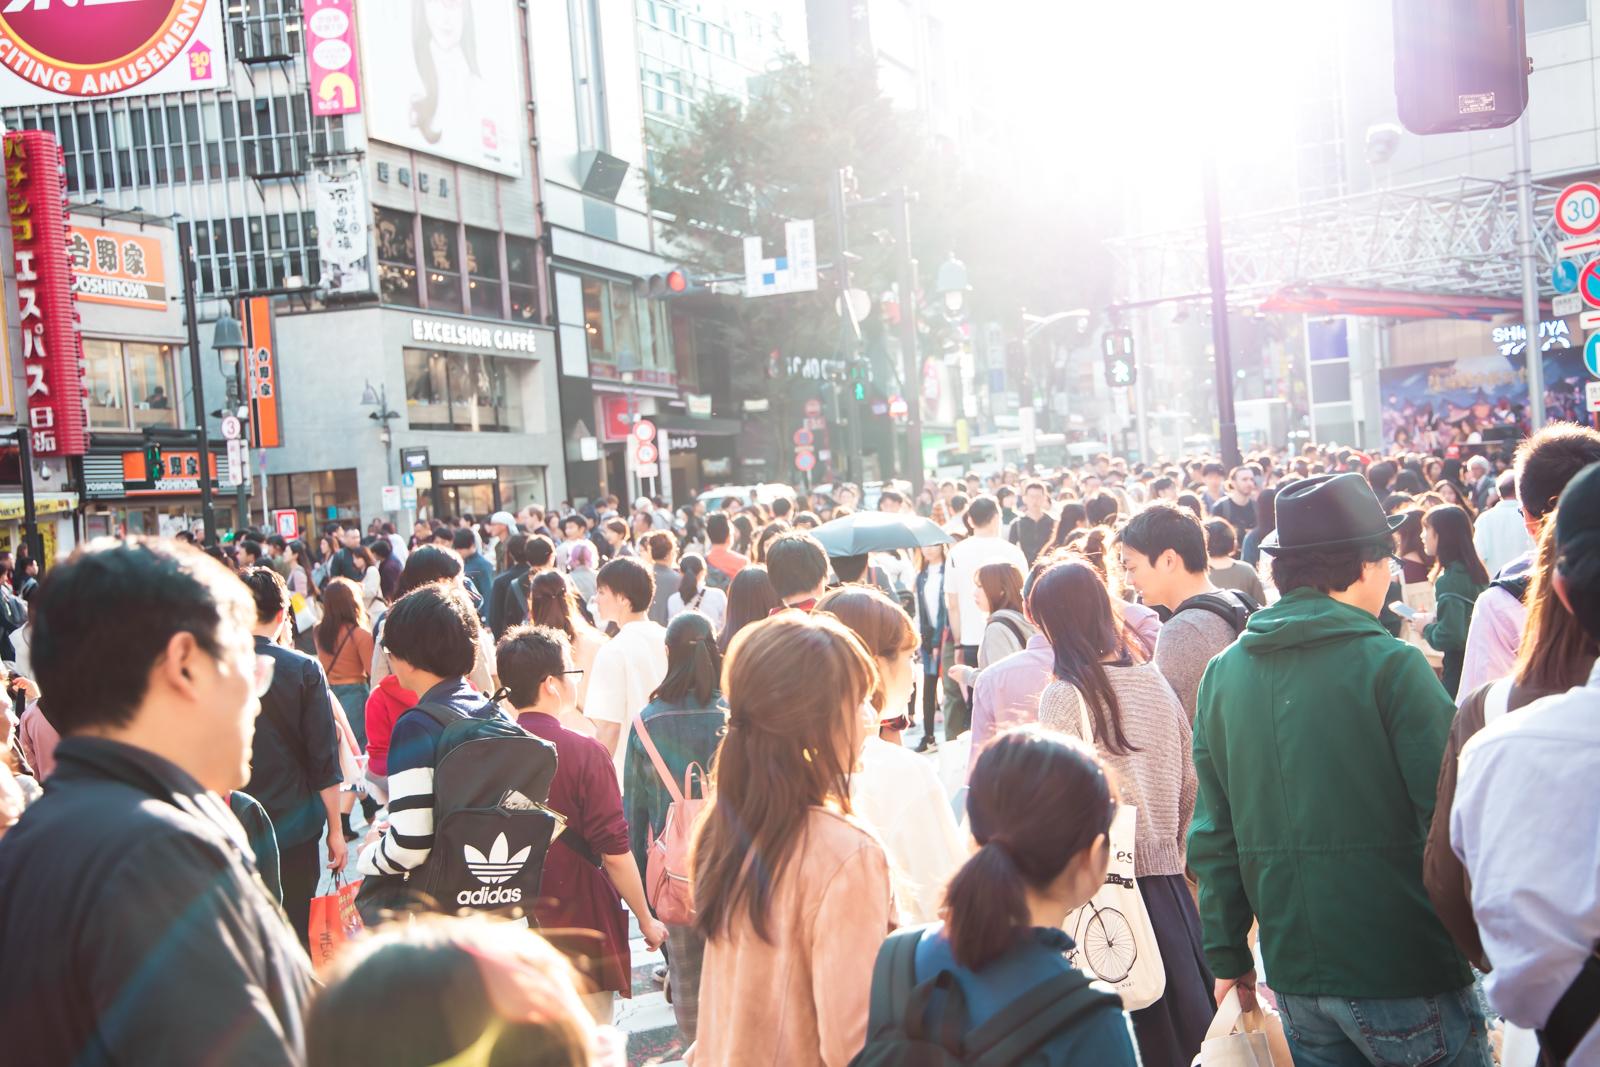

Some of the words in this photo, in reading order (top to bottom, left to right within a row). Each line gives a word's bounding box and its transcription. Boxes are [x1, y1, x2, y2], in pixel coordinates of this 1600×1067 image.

[0, 33, 71, 92] CITING
[1567, 197, 1595, 222] 30
[69, 235, 144, 274] 吉野家
[412, 319, 492, 348] EXCELSIOR
[494, 329, 536, 353] CAFFÉ
[1492, 320, 1569, 342] SHIYA
[15, 251, 57, 452] エスパス日拓
[668, 437, 697, 450] MAS
[457, 886, 522, 905] adidas
